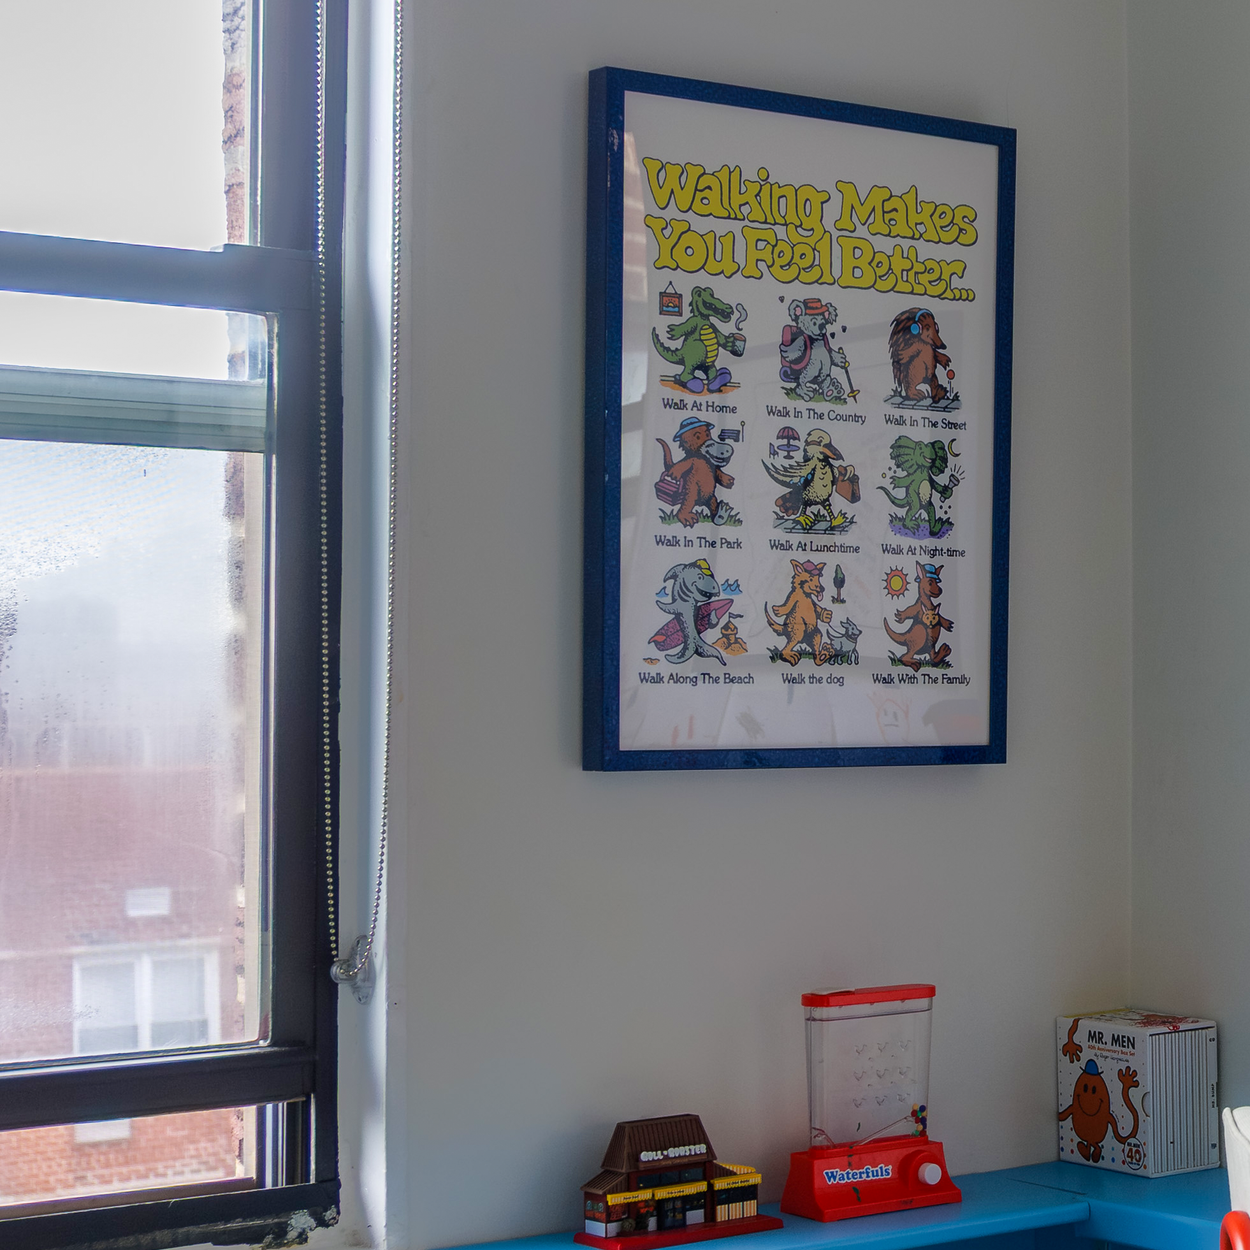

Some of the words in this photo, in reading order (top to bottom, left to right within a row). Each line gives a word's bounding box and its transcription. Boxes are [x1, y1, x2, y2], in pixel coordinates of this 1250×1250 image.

[642, 156, 831, 239] Walking
[835, 180, 979, 246] Makes
[644, 215, 741, 278] You
[741, 226, 836, 285] Feel
[836, 235, 976, 302] Better...
[662, 398, 688, 411] Walk
[691, 400, 703, 412] At
[705, 401, 738, 414] Home
[766, 405, 790, 418] Walk
[793, 407, 803, 419] In
[806, 408, 825, 421] The
[827, 410, 867, 426] Country
[884, 413, 908, 427] Walk
[909, 416, 919, 427] In
[921, 417, 939, 429] The
[941, 418, 967, 431] Street
[654, 534, 681, 547] Walk
[684, 536, 694, 548] In
[696, 536, 717, 549] The
[720, 537, 743, 549] Park
[769, 539, 794, 551] Walk
[796, 541, 807, 552] At
[809, 541, 861, 554] Lunchtime
[881, 543, 904, 556] Walk
[905, 544, 917, 556] At
[919, 544, 966, 559] Night-time
[638, 672, 666, 685] Walk
[667, 673, 698, 687] Along
[700, 672, 721, 685] The
[723, 672, 755, 685] Beach
[781, 673, 806, 685] Walk
[808, 673, 824, 685] the
[825, 673, 845, 687] dog
[872, 672, 896, 685] Walk
[898, 672, 918, 685] With
[920, 672, 939, 685] The
[941, 672, 971, 687] Family
[1087, 1029, 1108, 1046] MR.
[1111, 1033, 1136, 1050] MEN
[1126, 1147, 1142, 1163] 40
[823, 1164, 892, 1185] Waterfuls
